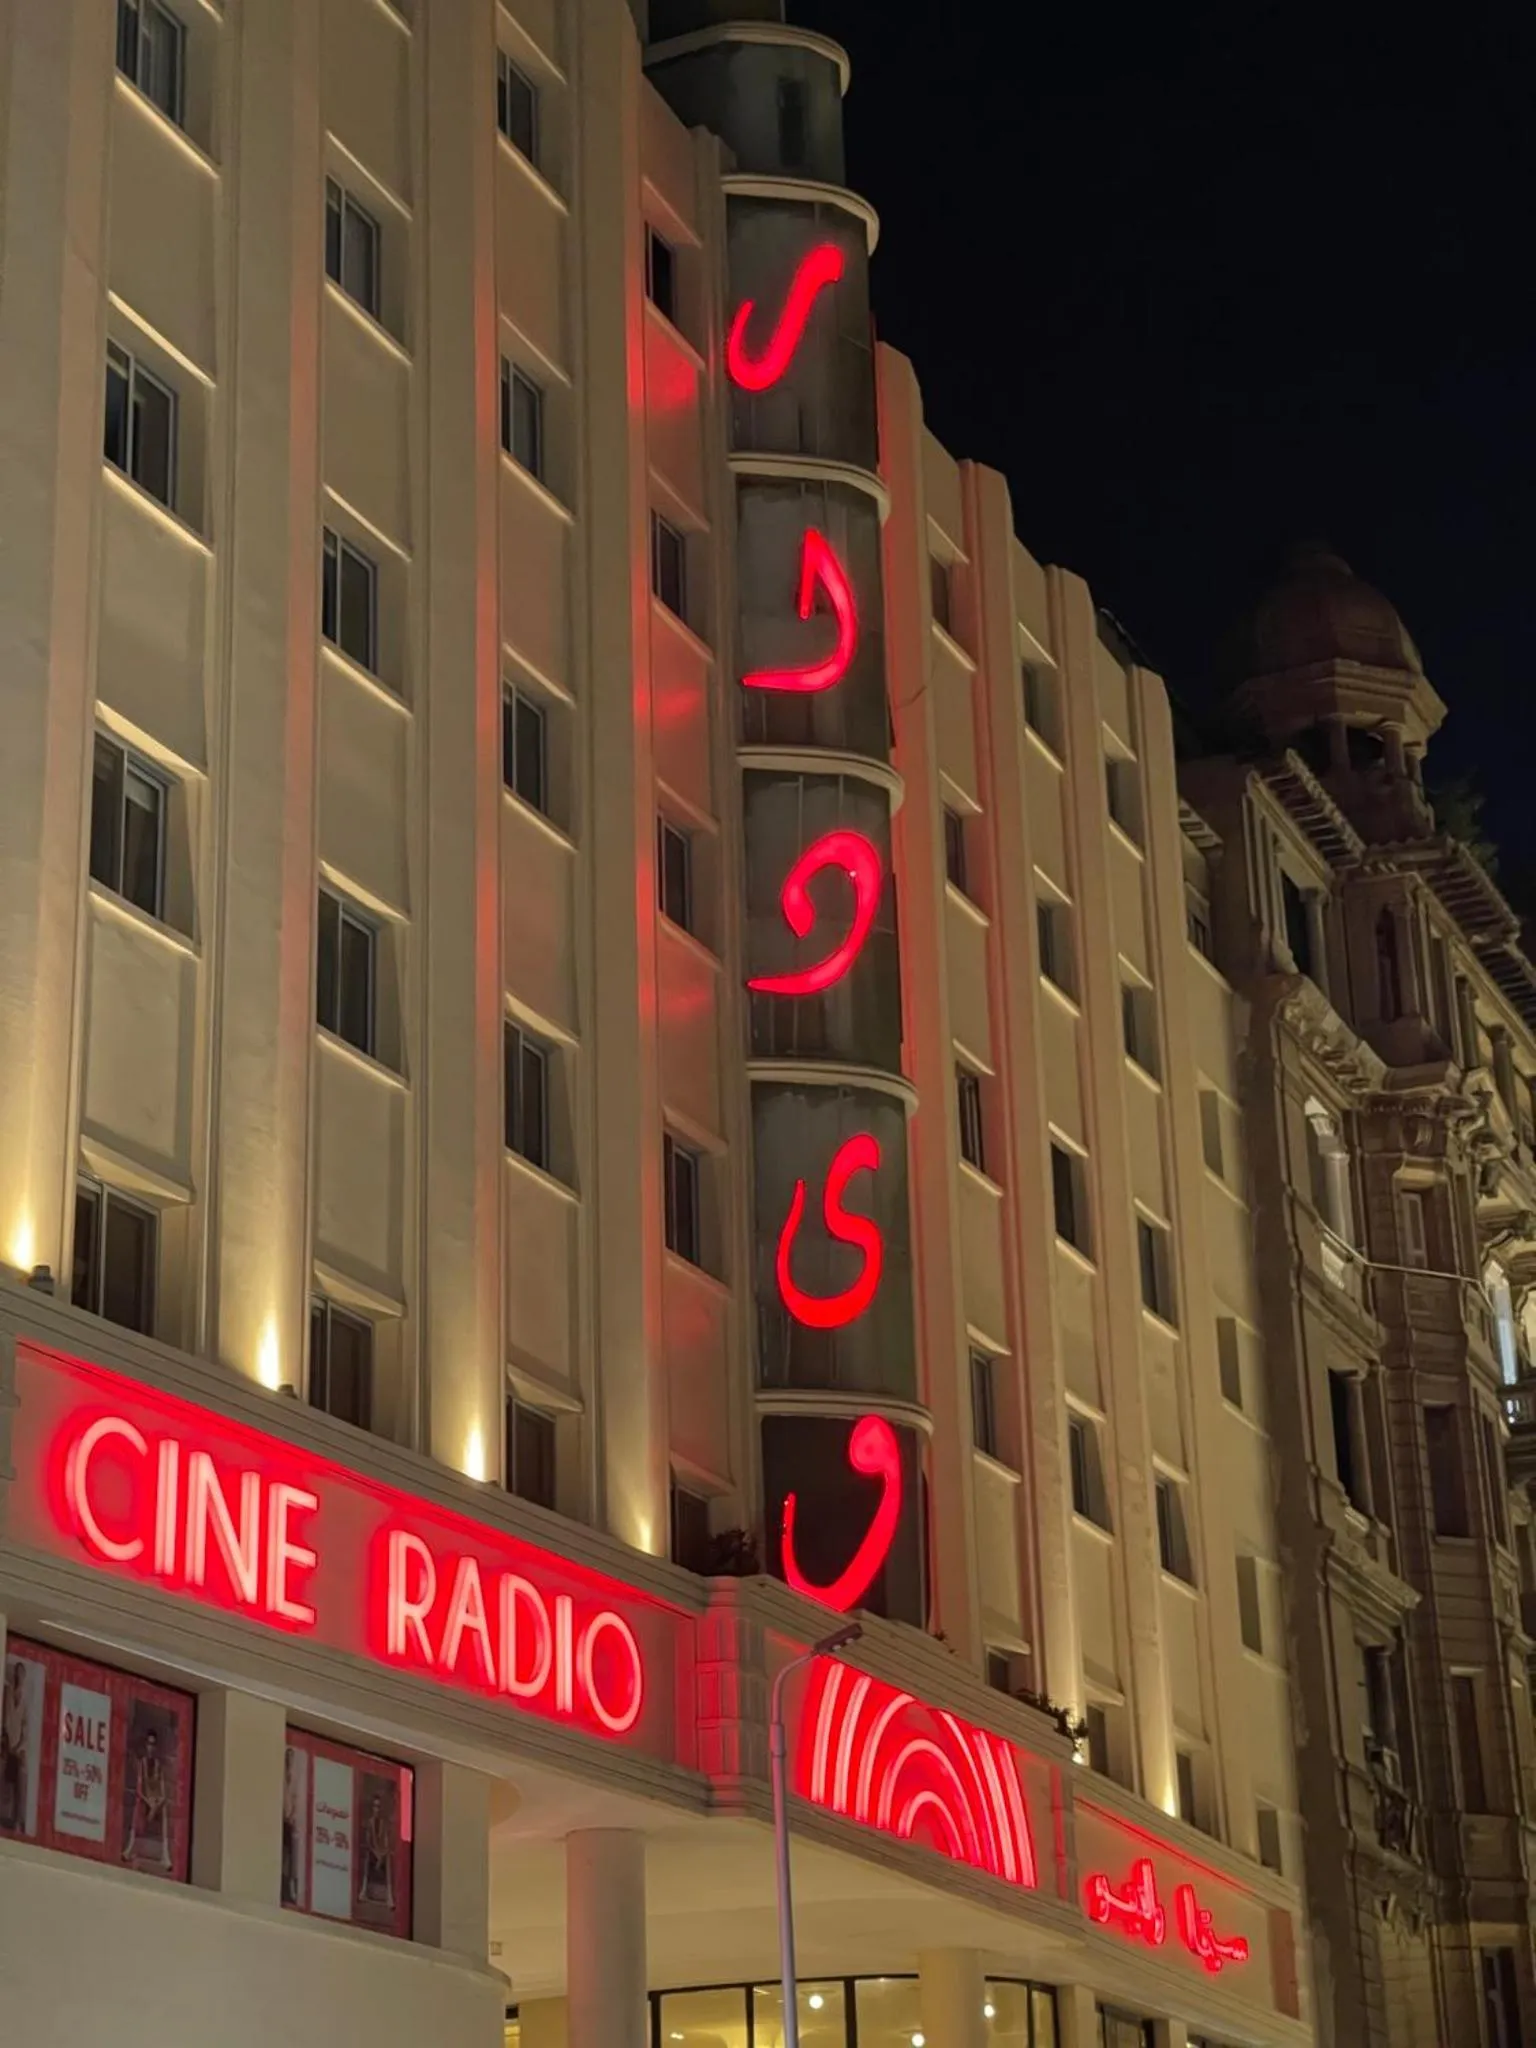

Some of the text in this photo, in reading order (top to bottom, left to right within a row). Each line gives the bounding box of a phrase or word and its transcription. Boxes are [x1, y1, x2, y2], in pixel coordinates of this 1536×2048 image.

[65, 1415, 645, 1735] CINE RADIO
[63, 1711, 106, 1753] SALE
